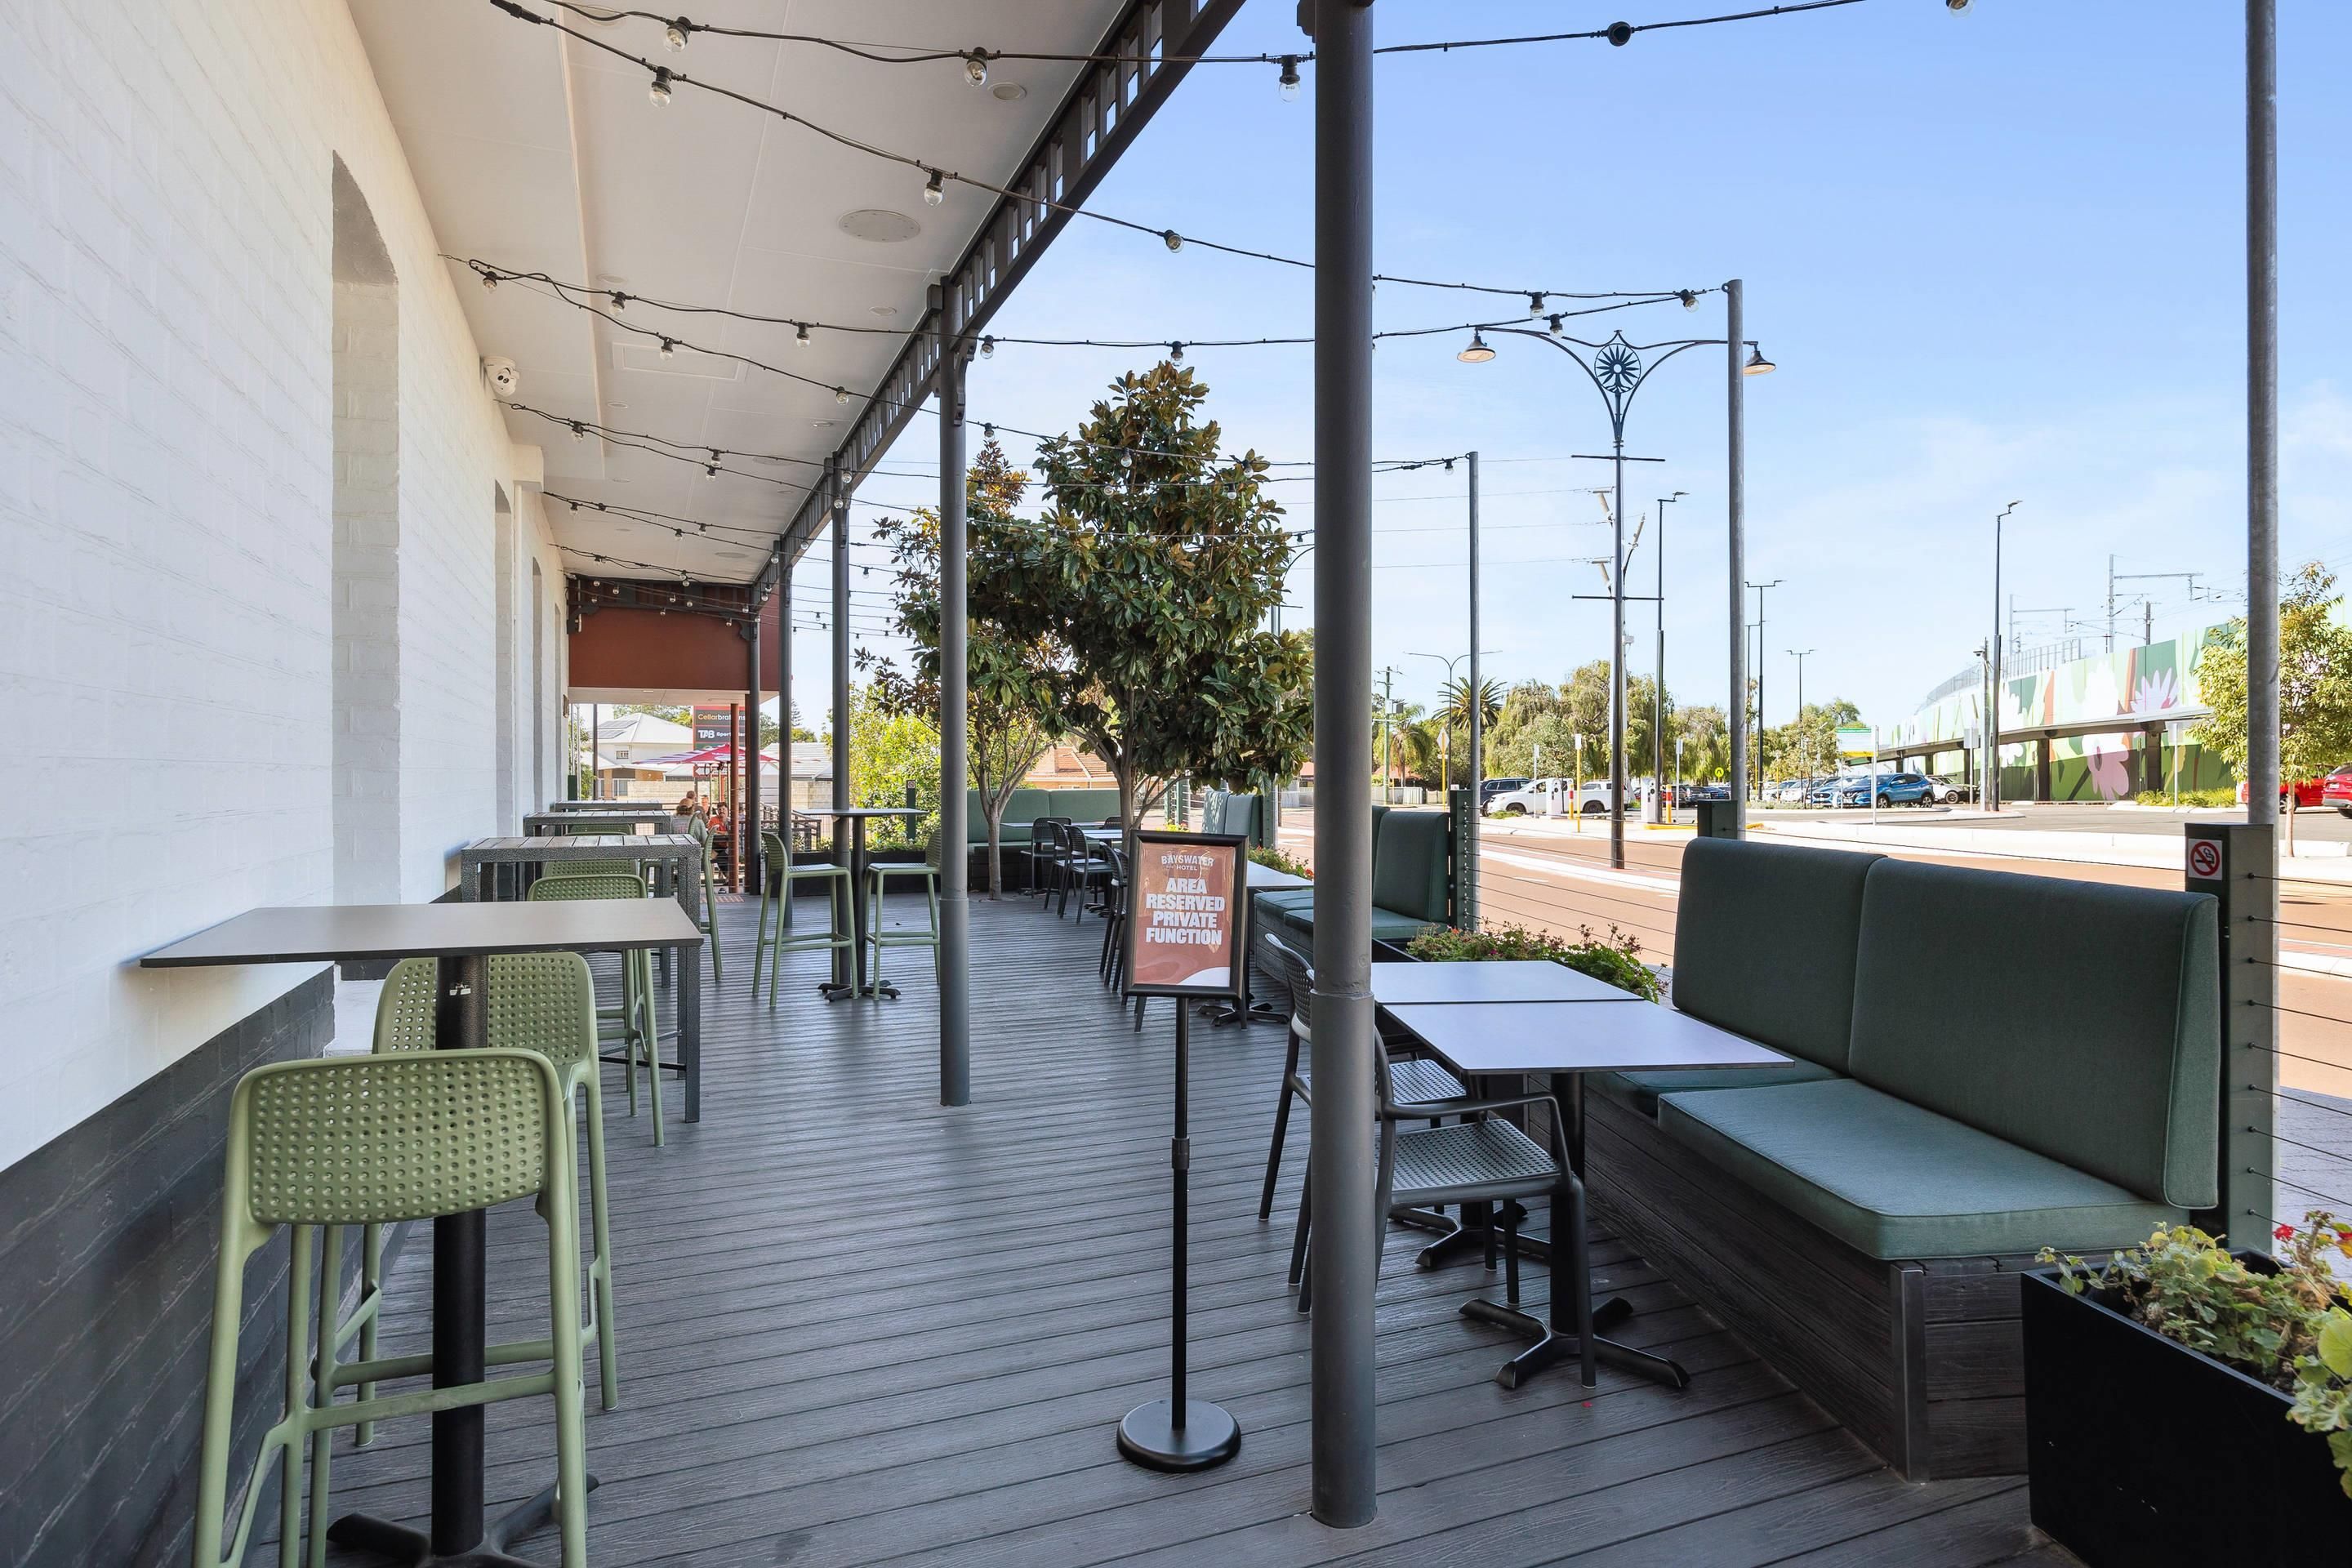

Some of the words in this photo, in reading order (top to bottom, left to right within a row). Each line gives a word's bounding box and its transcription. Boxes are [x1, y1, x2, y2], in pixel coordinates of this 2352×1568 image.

[697, 730, 715, 738] TAB
[1160, 854, 1214, 866] BAYSWATER
[1165, 877, 1207, 894] AREA
[1146, 893, 1225, 911] RESERVED
[1152, 911, 1217, 929] PRIVATE
[1145, 927, 1223, 945] FUNCTION
